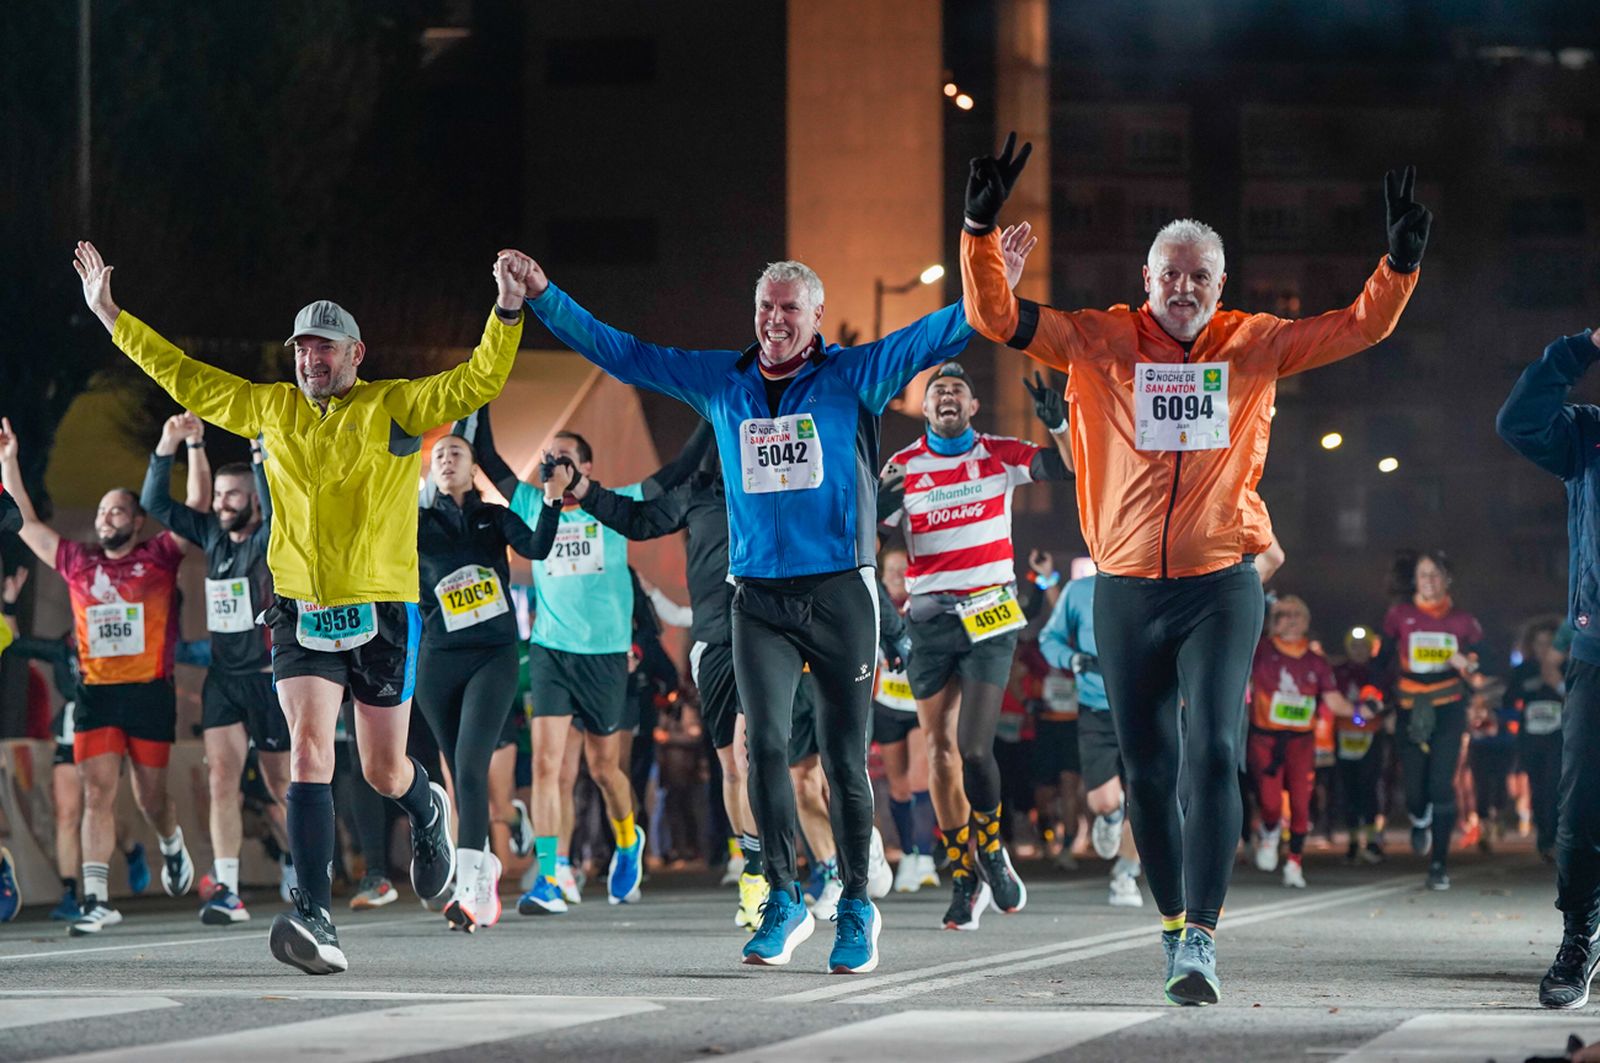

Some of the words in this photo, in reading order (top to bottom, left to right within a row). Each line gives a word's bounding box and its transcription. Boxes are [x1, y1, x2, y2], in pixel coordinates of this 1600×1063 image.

[1157, 373, 1183, 382] NOCHE
[1186, 373, 1196, 382] DE
[1145, 384, 1164, 393] SAN
[1152, 394, 1214, 421] 6094
[750, 436, 765, 445] SAN
[757, 441, 808, 467] 5042
[925, 484, 982, 503] Alhambra
[927, 509, 951, 526] 100
[951, 503, 986, 520] años
[555, 541, 591, 558] 2130
[448, 581, 493, 609] 12064
[312, 607, 361, 633] 7958
[975, 604, 1011, 628] 4613
[99, 622, 132, 639] 1356
